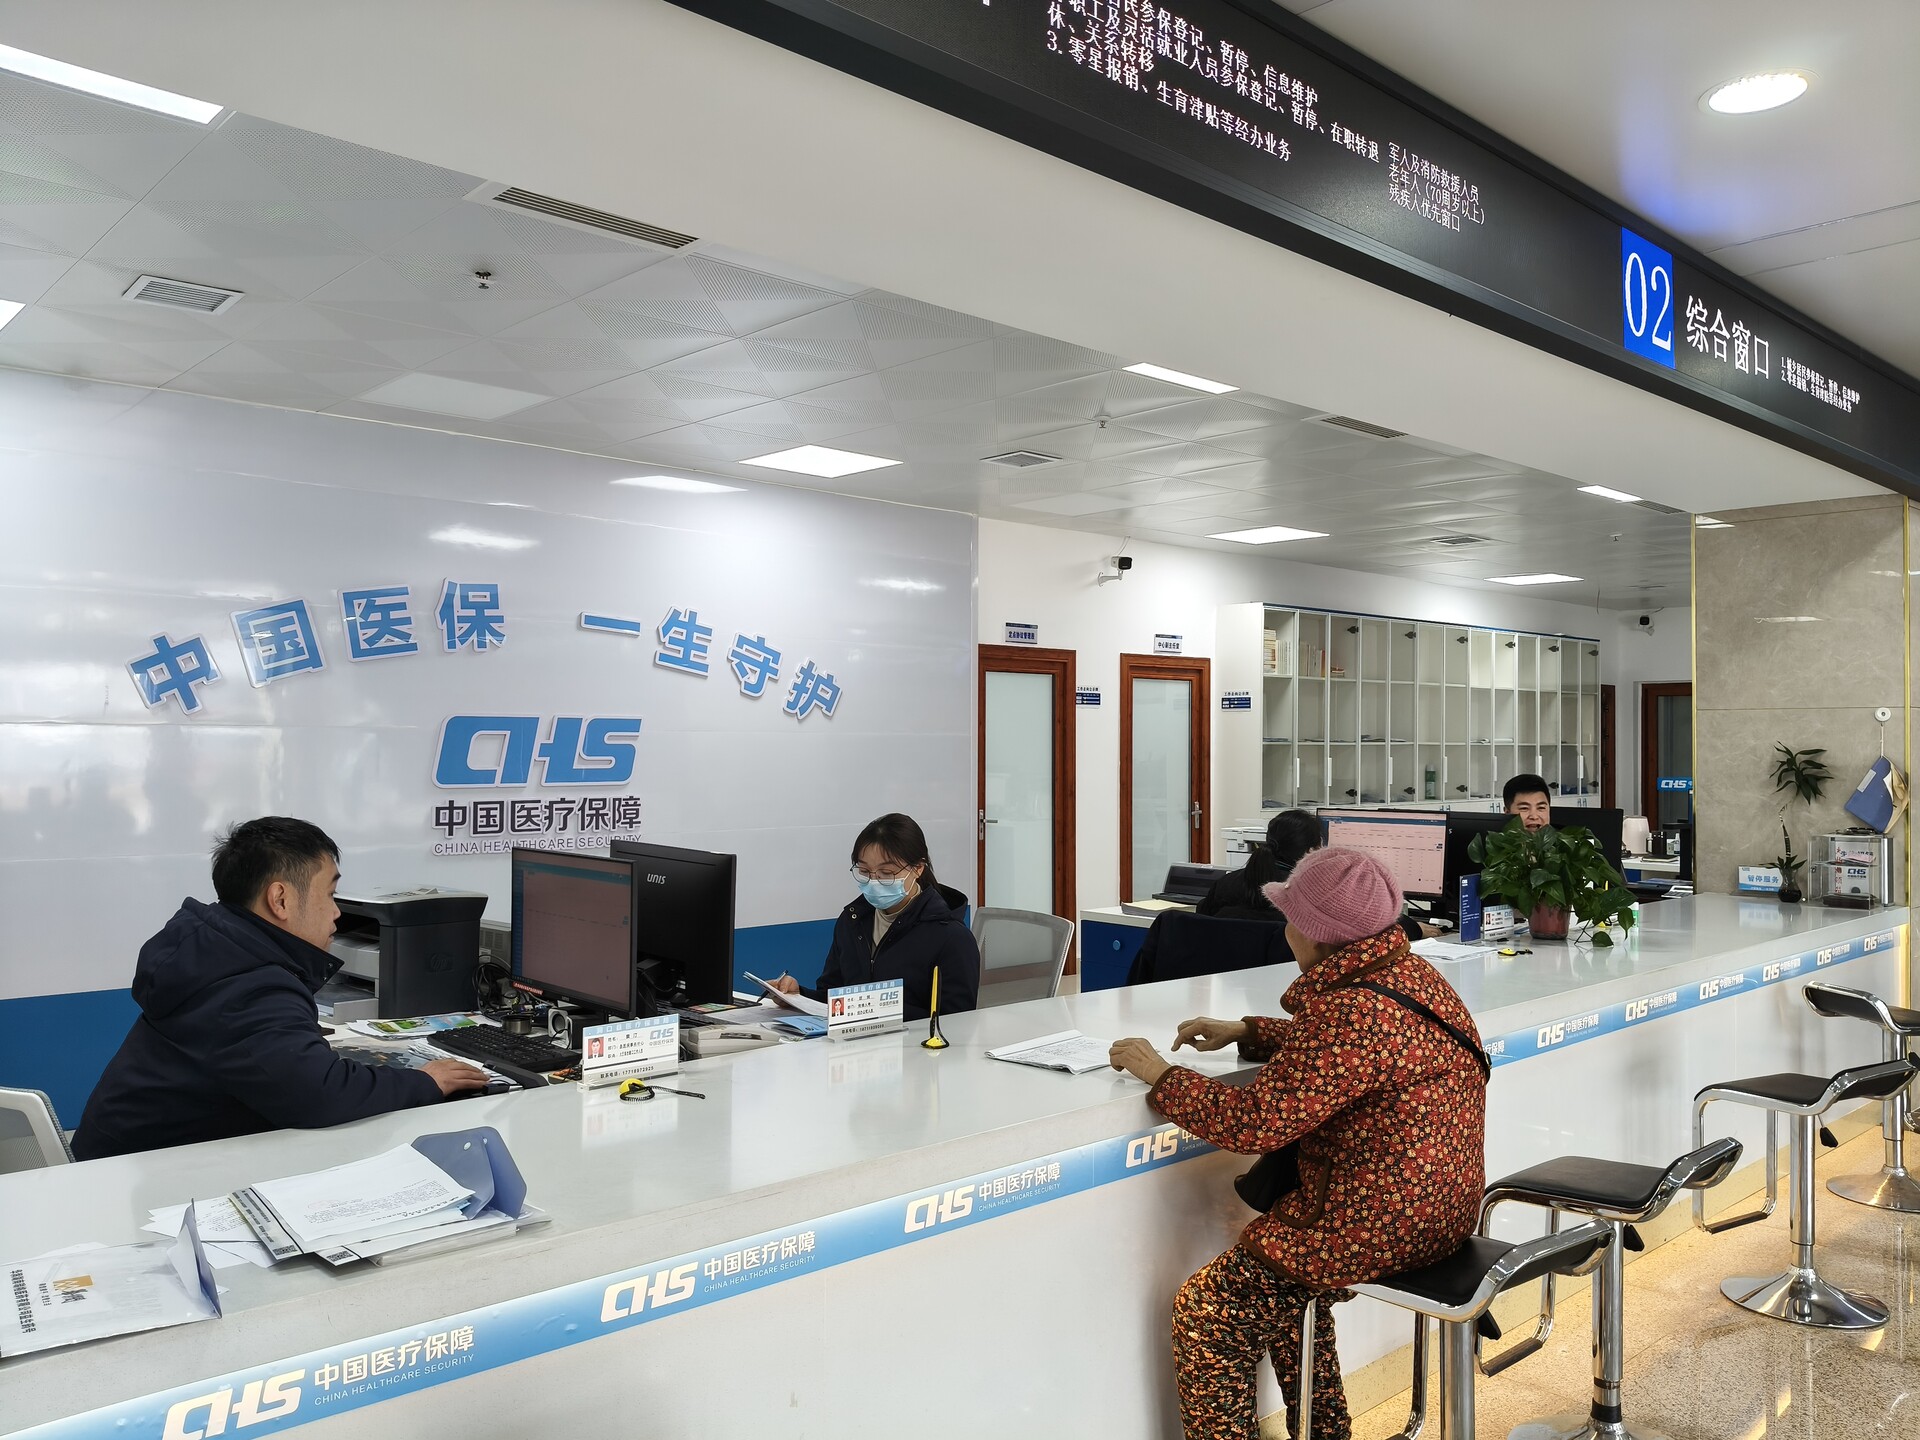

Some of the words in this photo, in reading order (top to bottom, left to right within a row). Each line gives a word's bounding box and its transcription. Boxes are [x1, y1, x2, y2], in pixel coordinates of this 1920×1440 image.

[1047, 1, 1155, 72] 休、关系转移
[1060, 0, 1379, 163] 职工及灵活就业人员参保登记、暂停、在职转退
[1388, 141, 1479, 206] 军人及消防救援人员
[1388, 182, 1460, 232] 残疾人优先窗口
[1624, 251, 1672, 351] 02
[1685, 294, 1769, 380] 综合窗口
[128, 579, 507, 714] 中国医保
[580, 606, 842, 720] 一生守护
[434, 715, 642, 786] CHS
[1660, 779, 1688, 789] CHS
[434, 796, 642, 837] 中国医疗保障
[434, 842, 479, 854] CHINA
[647, 873, 667, 885] UNIS
[1762, 962, 1780, 982] CHS
[1816, 949, 1832, 966] CHS
[880, 990, 899, 1001] CHS
[1649, 992, 1677, 1009] 中国医疗保障
[1700, 979, 1719, 1000] CHS
[1566, 1013, 1600, 1034] 中国医疗保障
[1625, 998, 1649, 1023] CHS
[650, 1027, 674, 1040] CHS
[1482, 1040, 1505, 1055] 疗保障
[1537, 1022, 1566, 1049] CHS
[1125, 1127, 1180, 1168] CHS
[978, 1162, 1061, 1202] 中国医疗保障
[978, 1201, 997, 1212] CHINA
[997, 1191, 1034, 1207] HEALTHCARE
[1034, 1182, 1061, 1196] SECURITY
[904, 1184, 976, 1234] CHS
[704, 1230, 816, 1281] 中国医疗保障
[704, 1281, 728, 1293] CHINA
[730, 1266, 779, 1286] HEALTHCARE
[780, 1254, 816, 1271] SECURITY
[600, 1261, 699, 1323] CHS
[314, 1325, 475, 1391] 中国医疗保障
[314, 1390, 349, 1406] CHINA
[351, 1369, 421, 1396] HEALTHCARE
[424, 1353, 475, 1377] SECURITY
[162, 1368, 305, 1440] CHS
